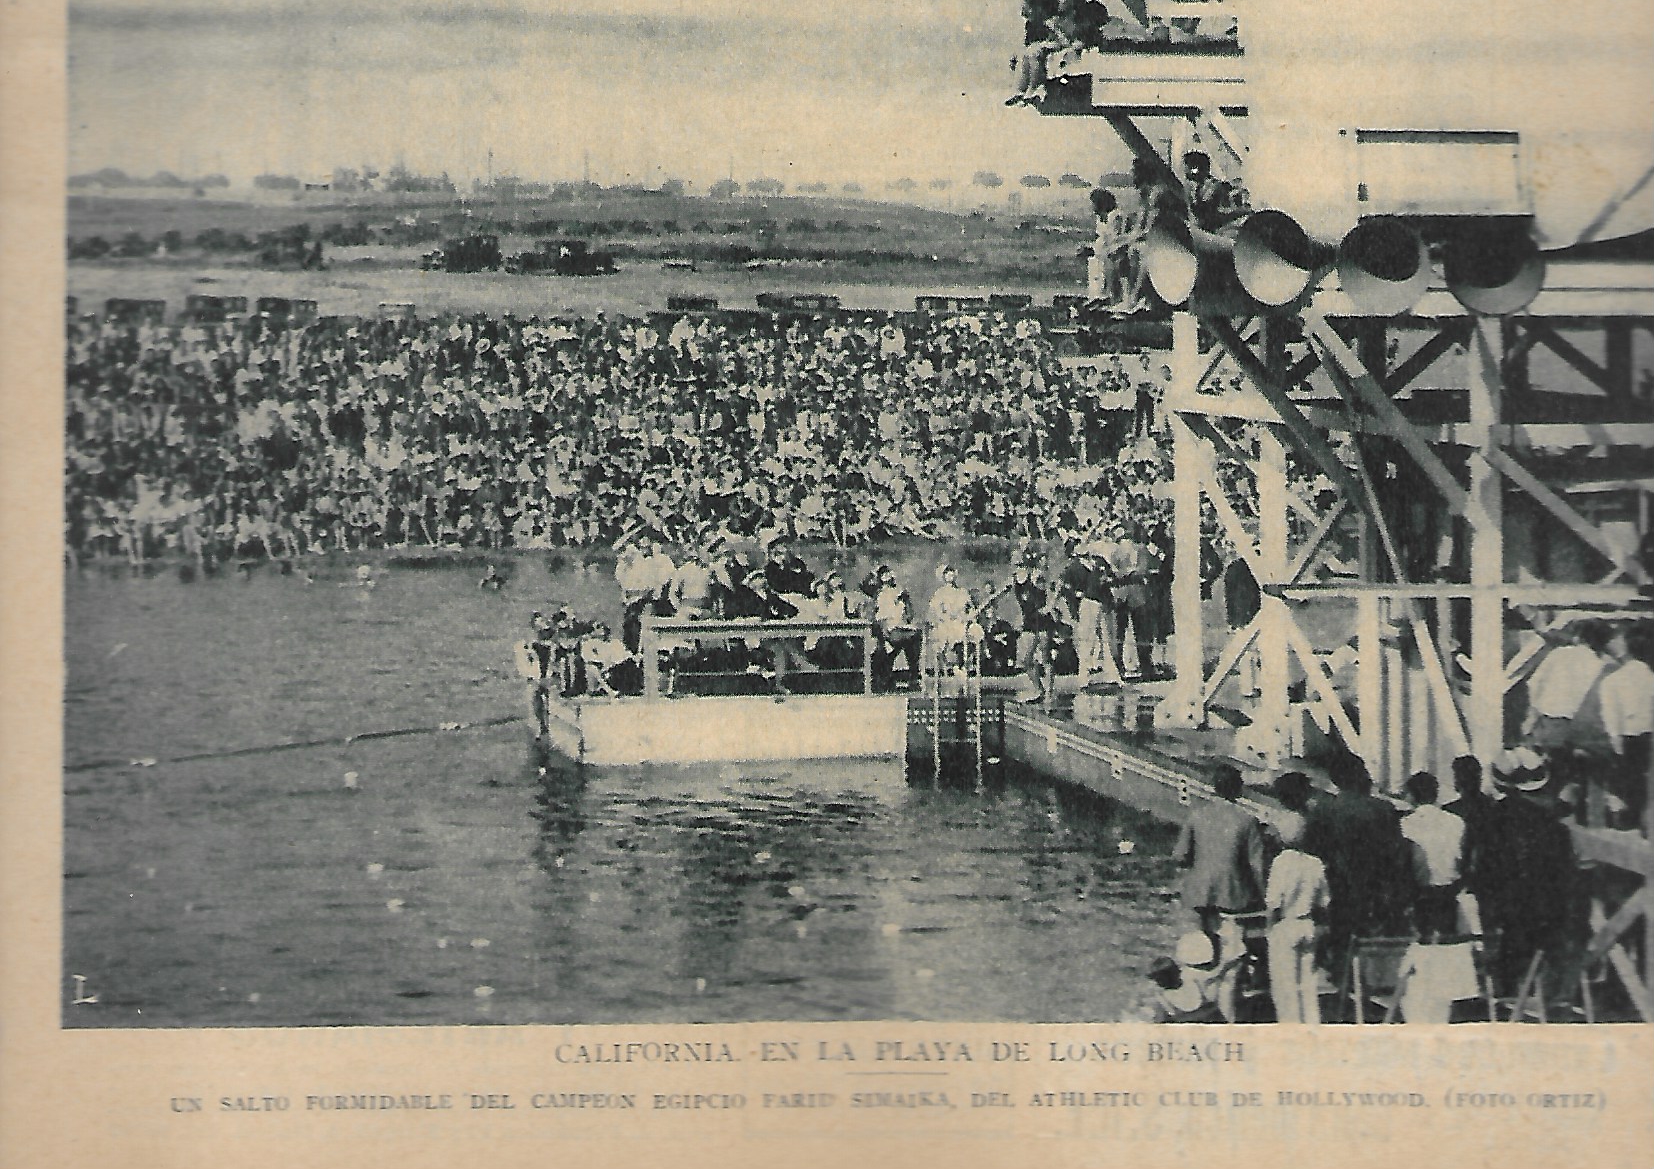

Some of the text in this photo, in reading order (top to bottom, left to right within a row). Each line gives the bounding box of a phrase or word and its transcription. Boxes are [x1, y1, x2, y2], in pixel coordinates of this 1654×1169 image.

[817, 1040, 857, 1062] LA
[874, 1041, 974, 1062] PLAYA
[991, 1041, 1031, 1062] DE
[1049, 1041, 1130, 1062] LONG
[1147, 1041, 1244, 1062] BEACH
[170, 1097, 202, 1114] UN
[220, 1096, 289, 1112] SALTO
[305, 1094, 453, 1111] FORMIDABLE
[652, 1093, 747, 1110] EGIPCIO
[1028, 1091, 1144, 1108] ATHLETIC
[1159, 1091, 1218, 1107] CLUB
[1232, 1092, 1261, 1108] DE
